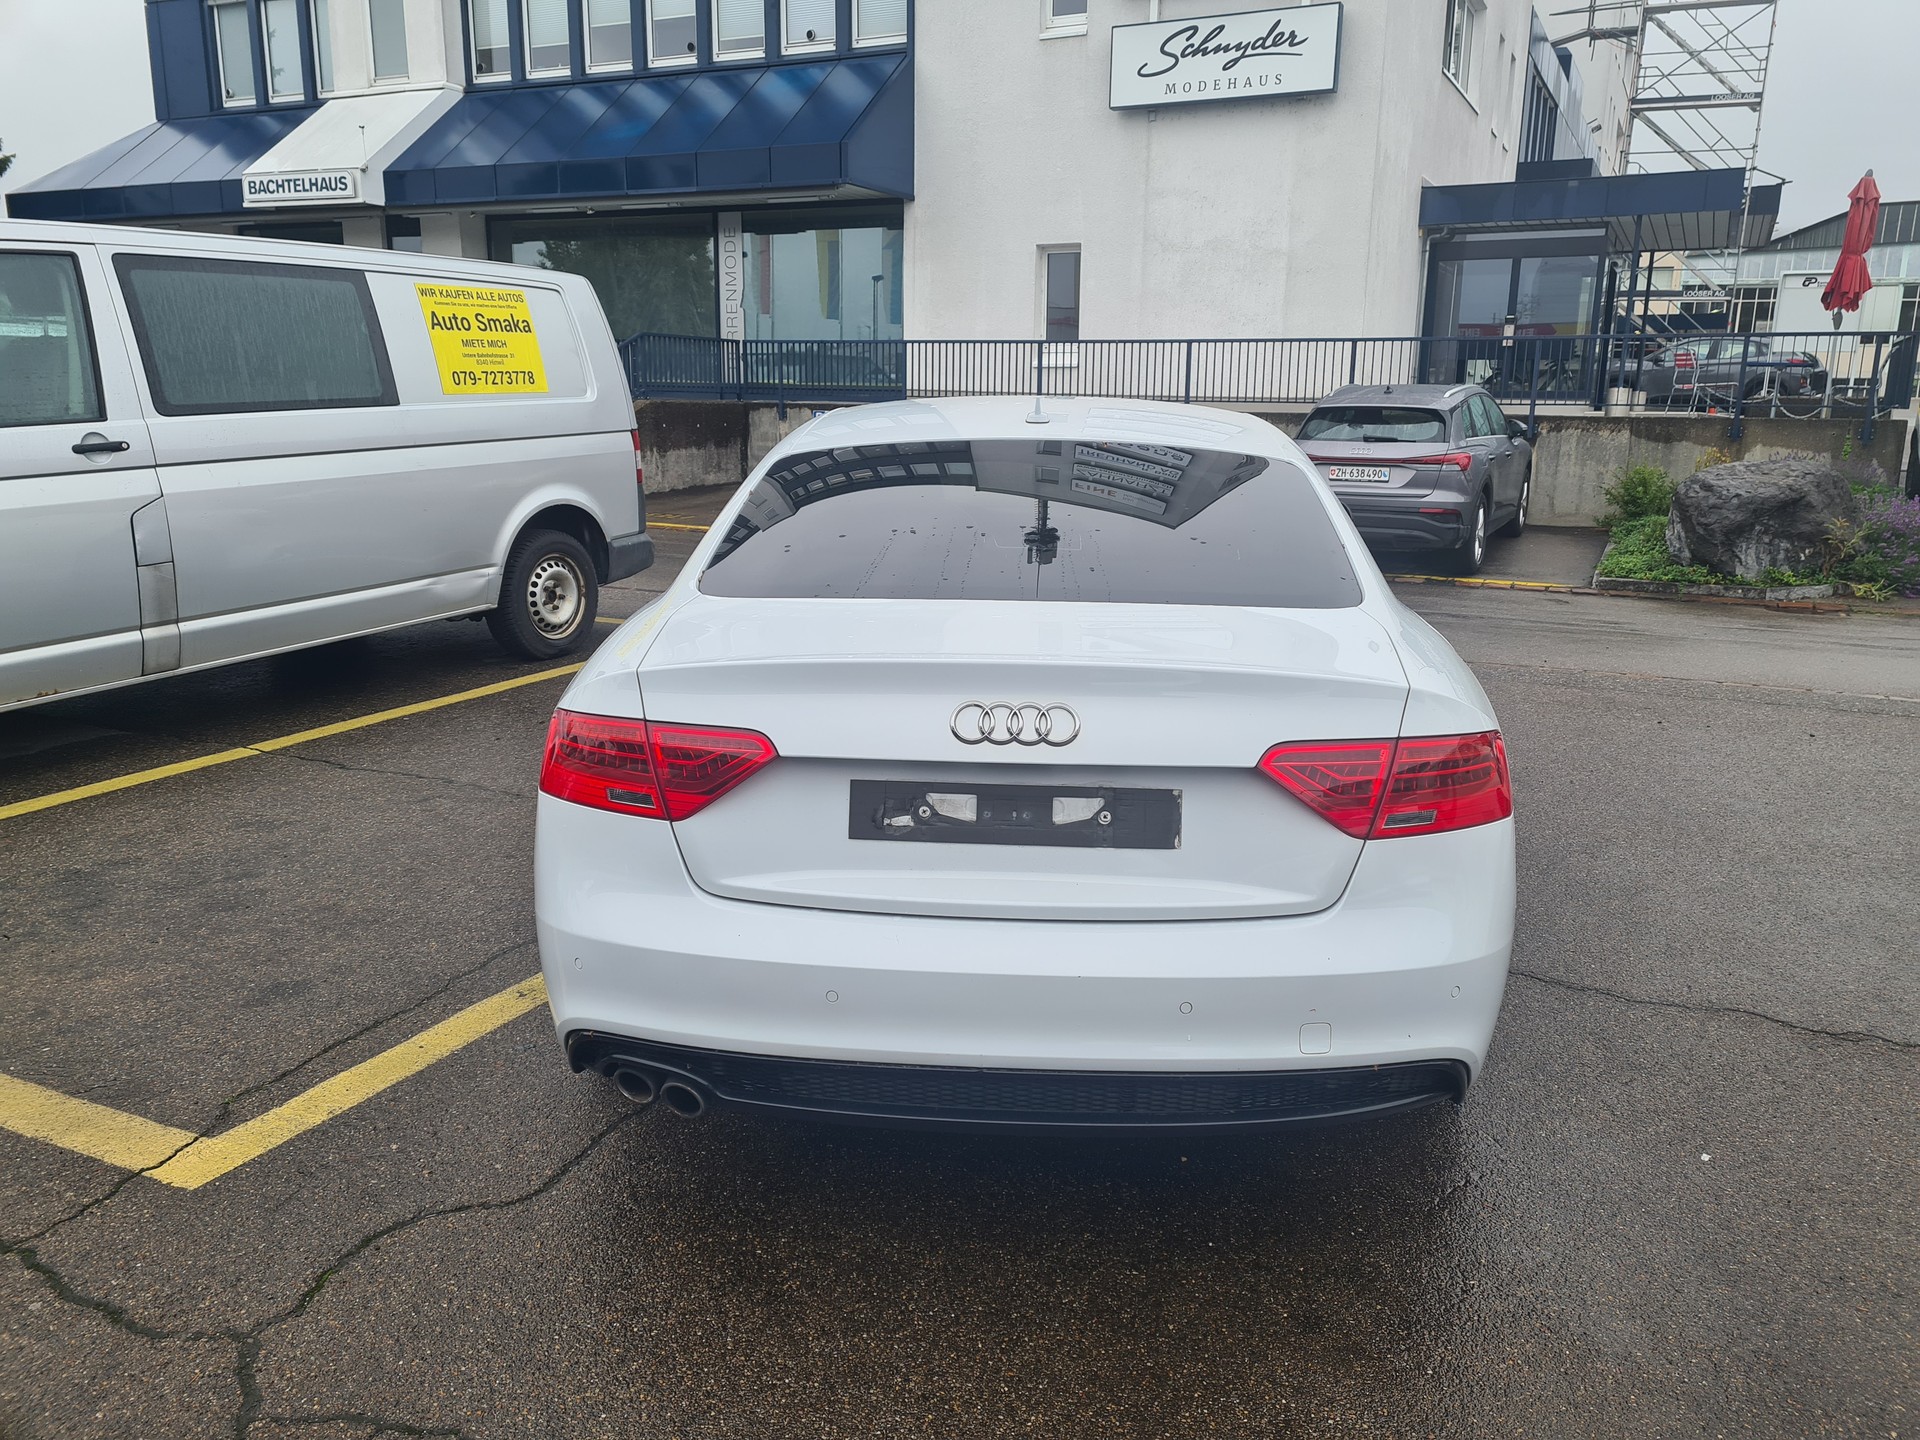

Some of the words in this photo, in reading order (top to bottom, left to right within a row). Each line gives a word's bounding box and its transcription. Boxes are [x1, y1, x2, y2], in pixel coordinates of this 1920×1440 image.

[1137, 19, 1309, 77] Schnyder
[1164, 73, 1283, 95] MODEHAUS
[248, 176, 348, 195] BACHTELHAUS
[418, 287, 438, 298] WIR
[438, 289, 474, 300] KAUFEN
[476, 291, 496, 302] ALLE
[497, 293, 524, 303] AUTOS
[723, 227, 738, 369] RRENMODE
[1683, 290, 1713, 298] LOOSER
[431, 311, 471, 332] Auto
[475, 313, 532, 333] Smaka
[461, 339, 486, 348] MIETE
[487, 340, 507, 348] MICH
[452, 371, 535, 386] 079-7273778
